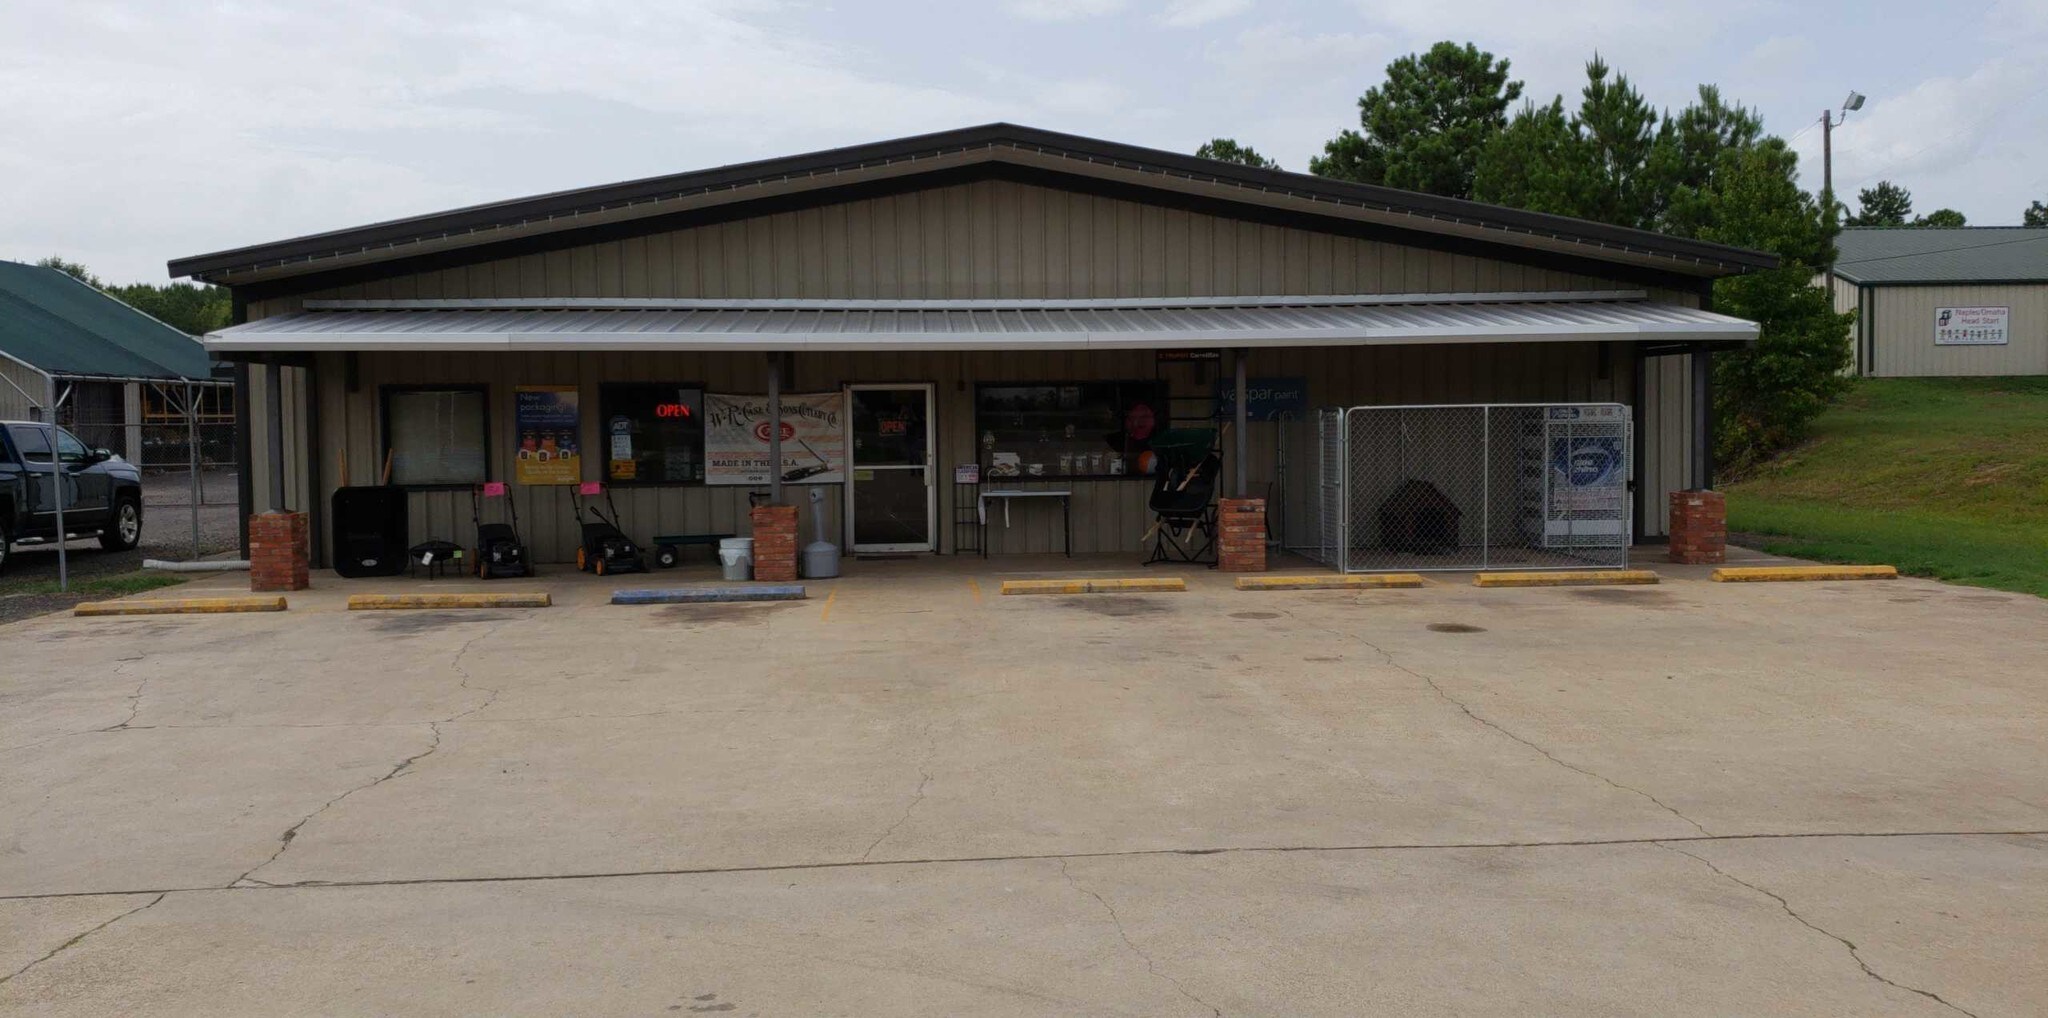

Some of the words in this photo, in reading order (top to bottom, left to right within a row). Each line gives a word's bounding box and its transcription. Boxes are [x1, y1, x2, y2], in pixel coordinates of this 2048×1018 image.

[1982, 317, 1999, 325] Start
[520, 393, 540, 401] New
[1274, 390, 1299, 402] paint
[656, 404, 691, 417] OPEN
[613, 421, 629, 430] ADT
[882, 420, 905, 431] OPEN
[712, 459, 740, 467] MADE
[741, 459, 752, 467] IN
[754, 459, 771, 467] THE
